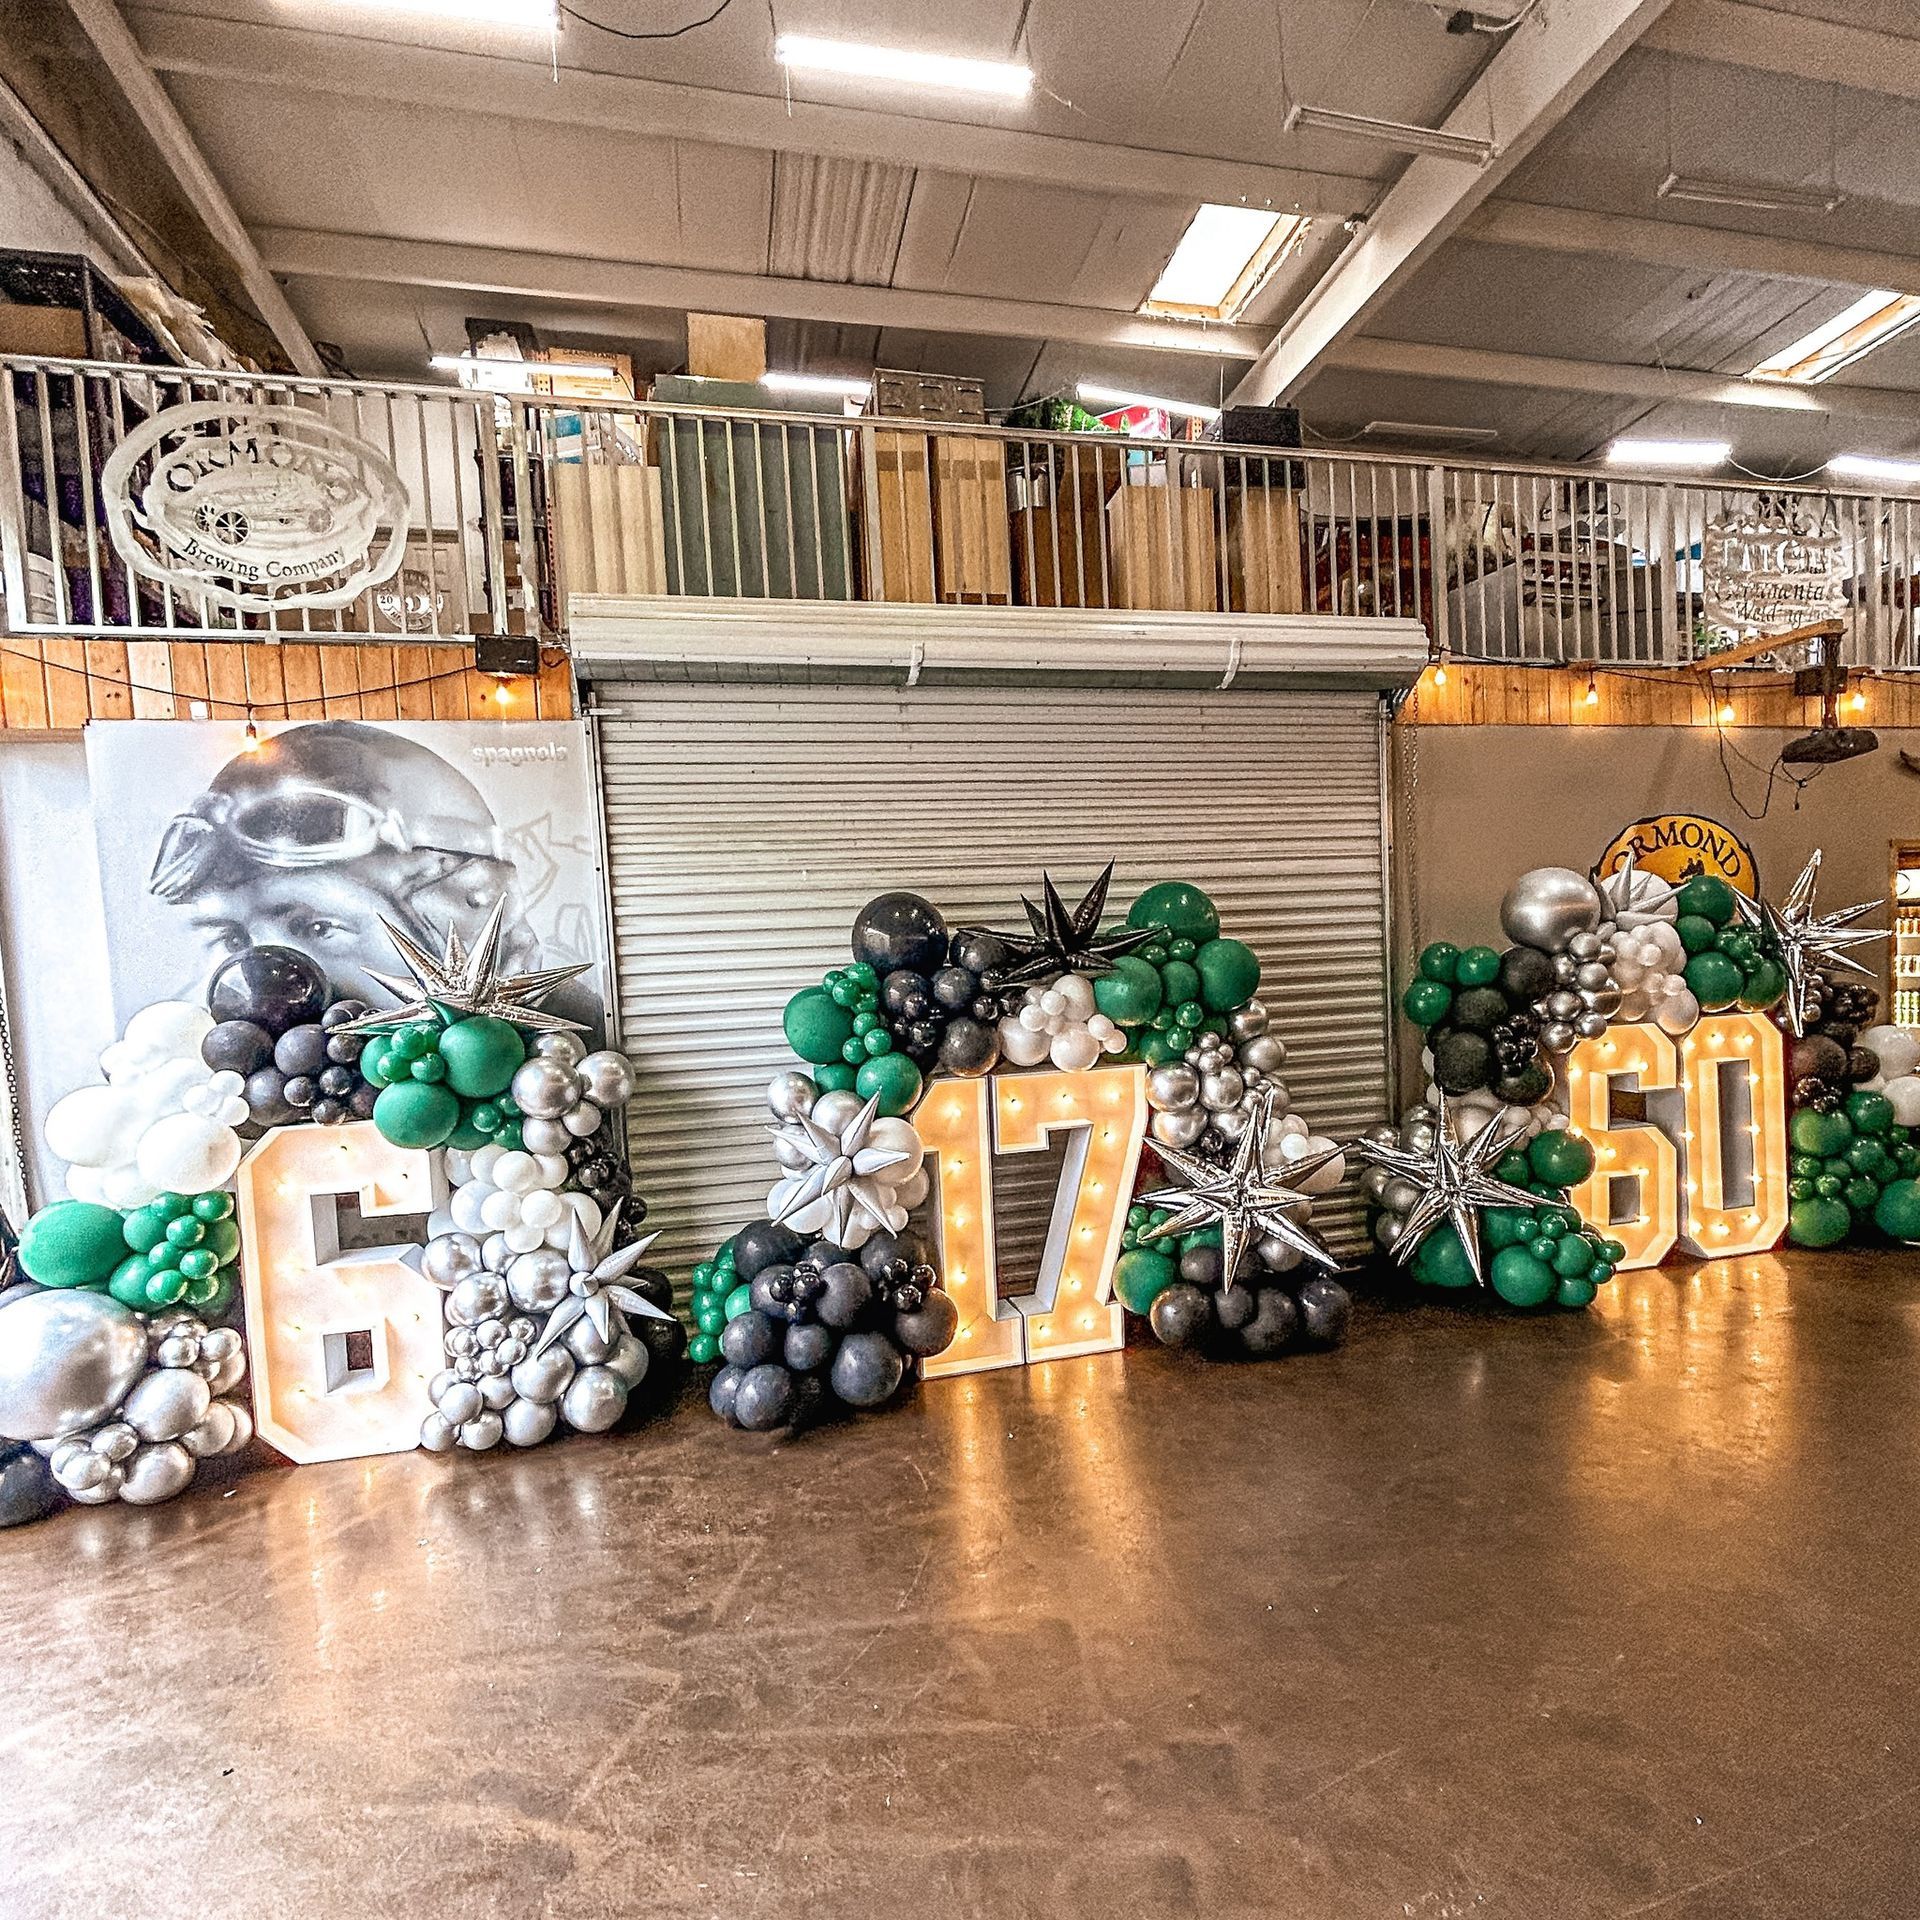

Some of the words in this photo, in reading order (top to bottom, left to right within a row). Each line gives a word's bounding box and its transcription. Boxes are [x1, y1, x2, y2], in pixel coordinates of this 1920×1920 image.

[182, 536, 260, 582] Brewing
[265, 545, 348, 578] Company
[1611, 820, 1742, 877] ORMOND
[910, 1063, 1149, 1380] 17
[1568, 1011, 1790, 1272] 60
[235, 1118, 450, 1466] 6
